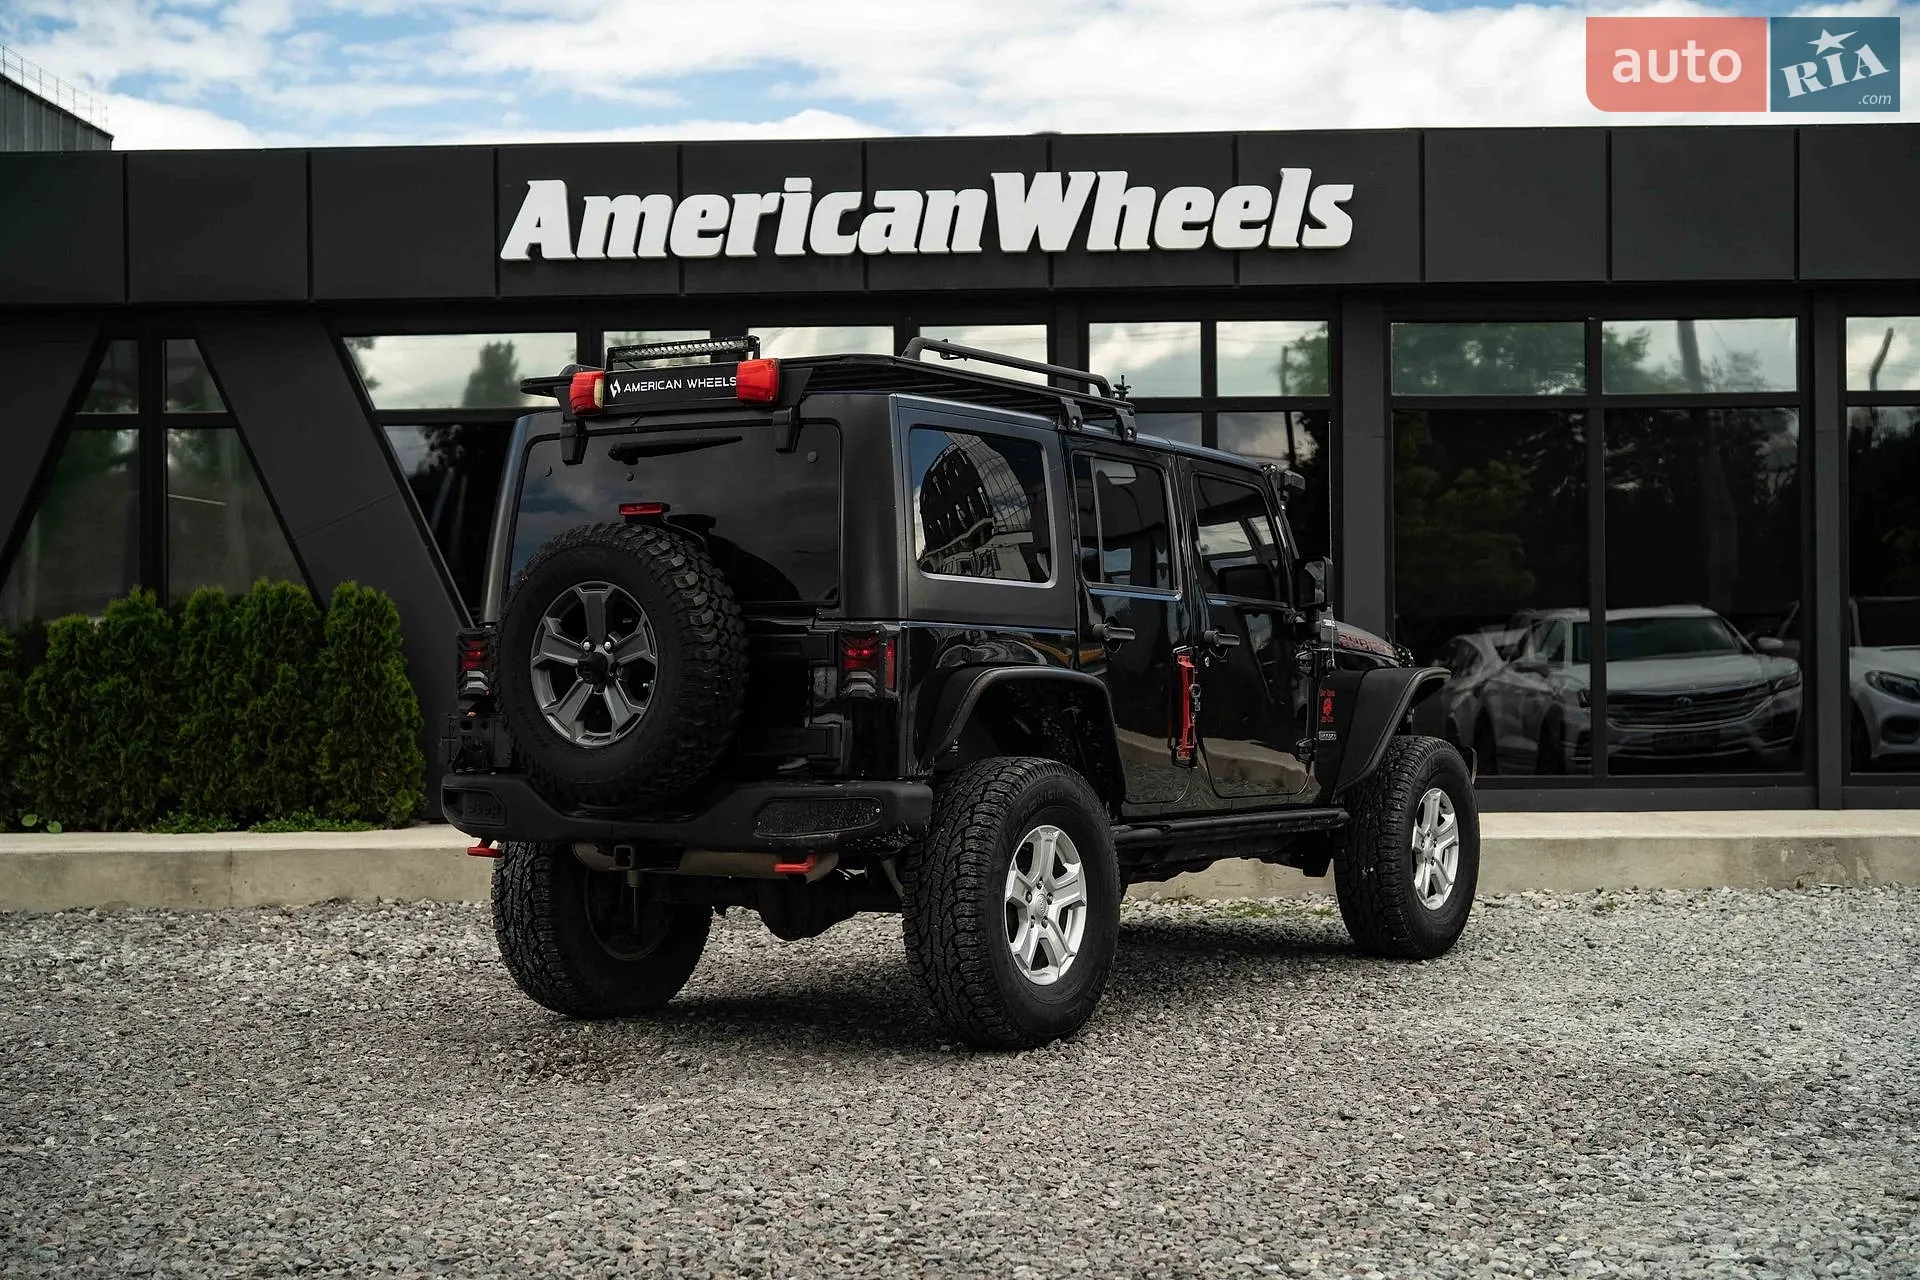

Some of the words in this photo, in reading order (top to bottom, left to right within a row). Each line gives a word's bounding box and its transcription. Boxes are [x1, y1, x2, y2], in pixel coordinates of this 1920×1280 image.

[499, 167, 1356, 262] AmericanWheels
[623, 379, 682, 393] AMERICAN
[686, 376, 737, 389] WHEELS
